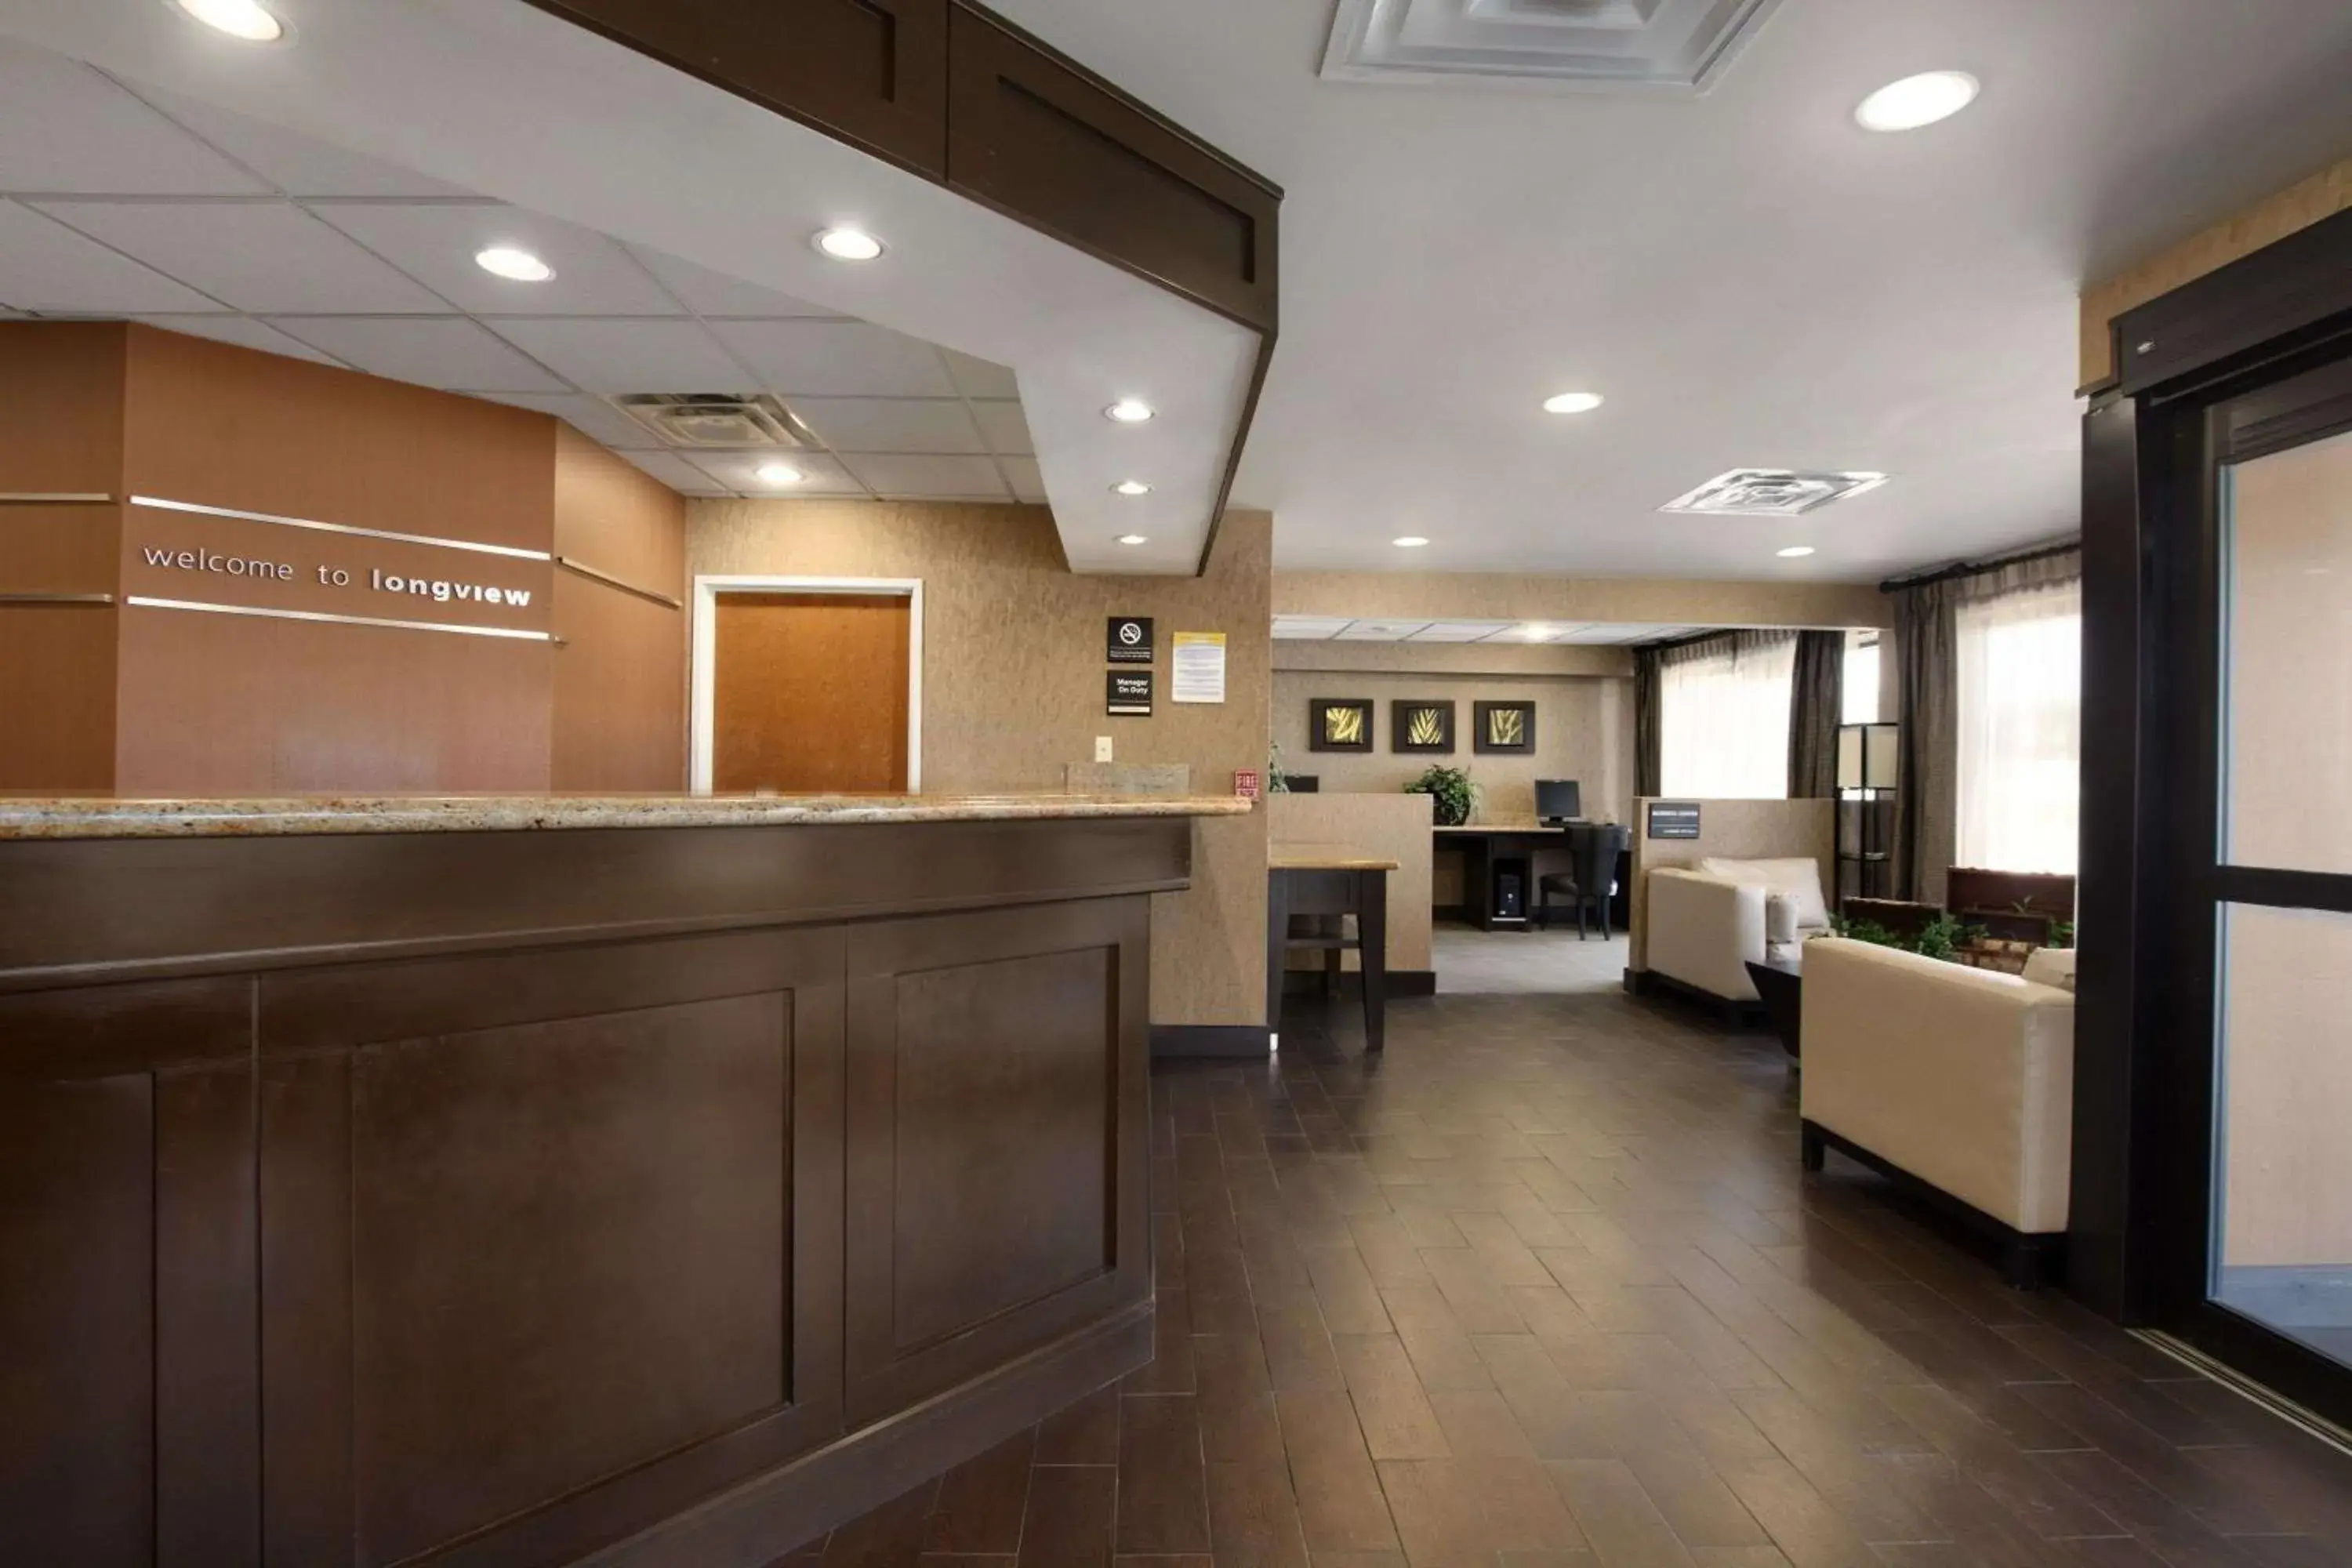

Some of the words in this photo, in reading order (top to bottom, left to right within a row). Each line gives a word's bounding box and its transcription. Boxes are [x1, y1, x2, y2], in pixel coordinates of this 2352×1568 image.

[144, 547, 293, 580] welcome
[318, 564, 349, 586] to
[372, 568, 531, 607] longview
